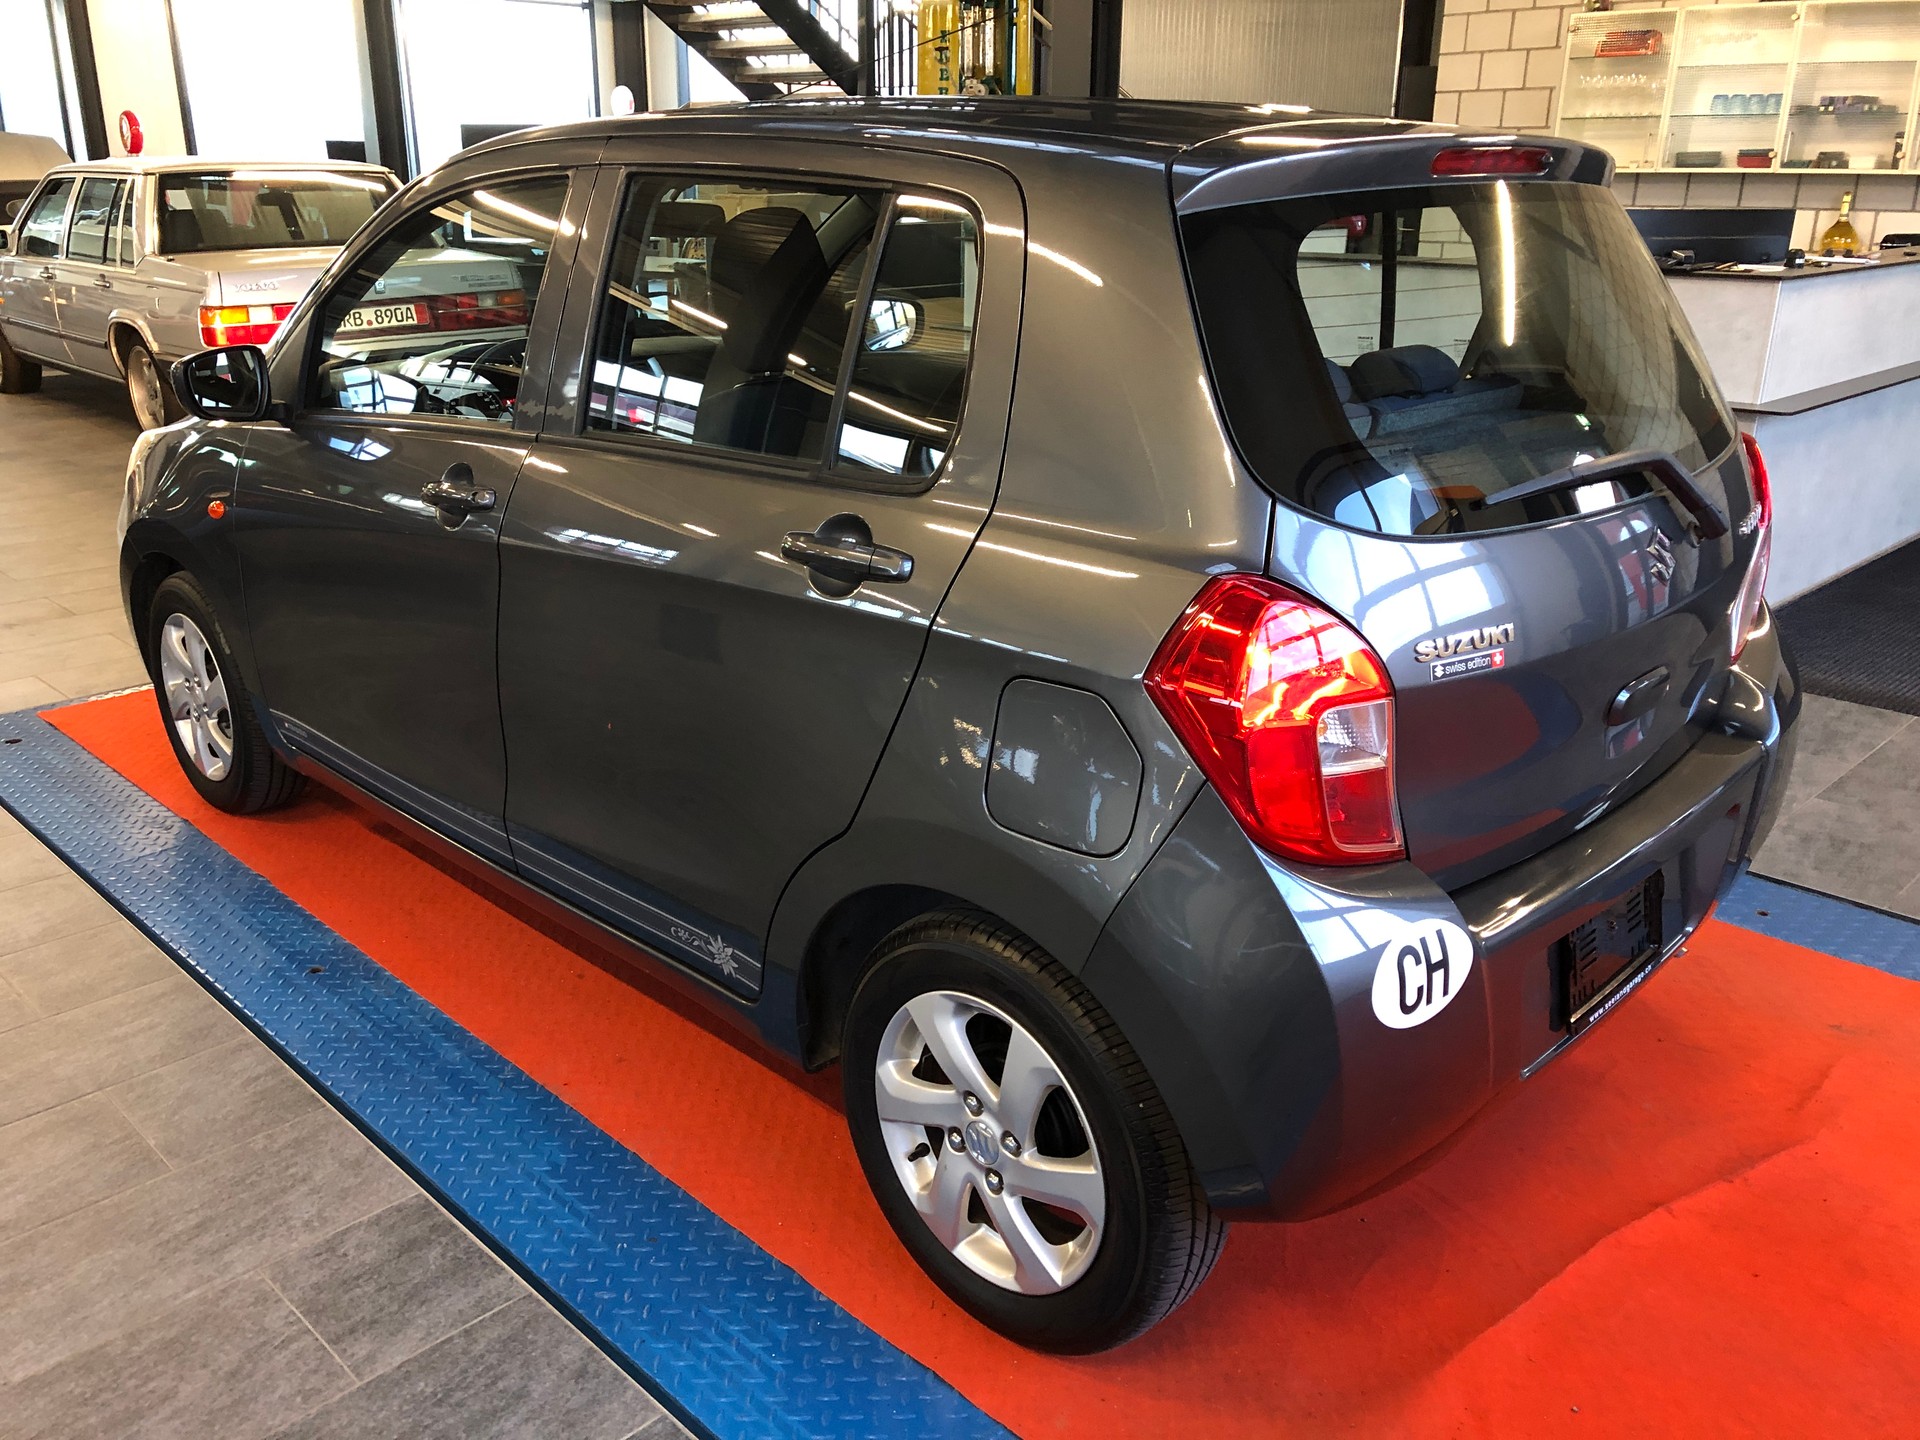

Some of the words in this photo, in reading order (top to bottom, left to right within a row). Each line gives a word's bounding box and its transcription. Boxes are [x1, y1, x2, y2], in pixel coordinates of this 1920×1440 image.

[1414, 622, 1515, 663] SUZUKI
[1445, 661, 1467, 675] swiss
[1467, 656, 1491, 670] edition
[1397, 929, 1450, 1015] CH
[1589, 965, 1652, 1022] www.seelandgarage.ch
